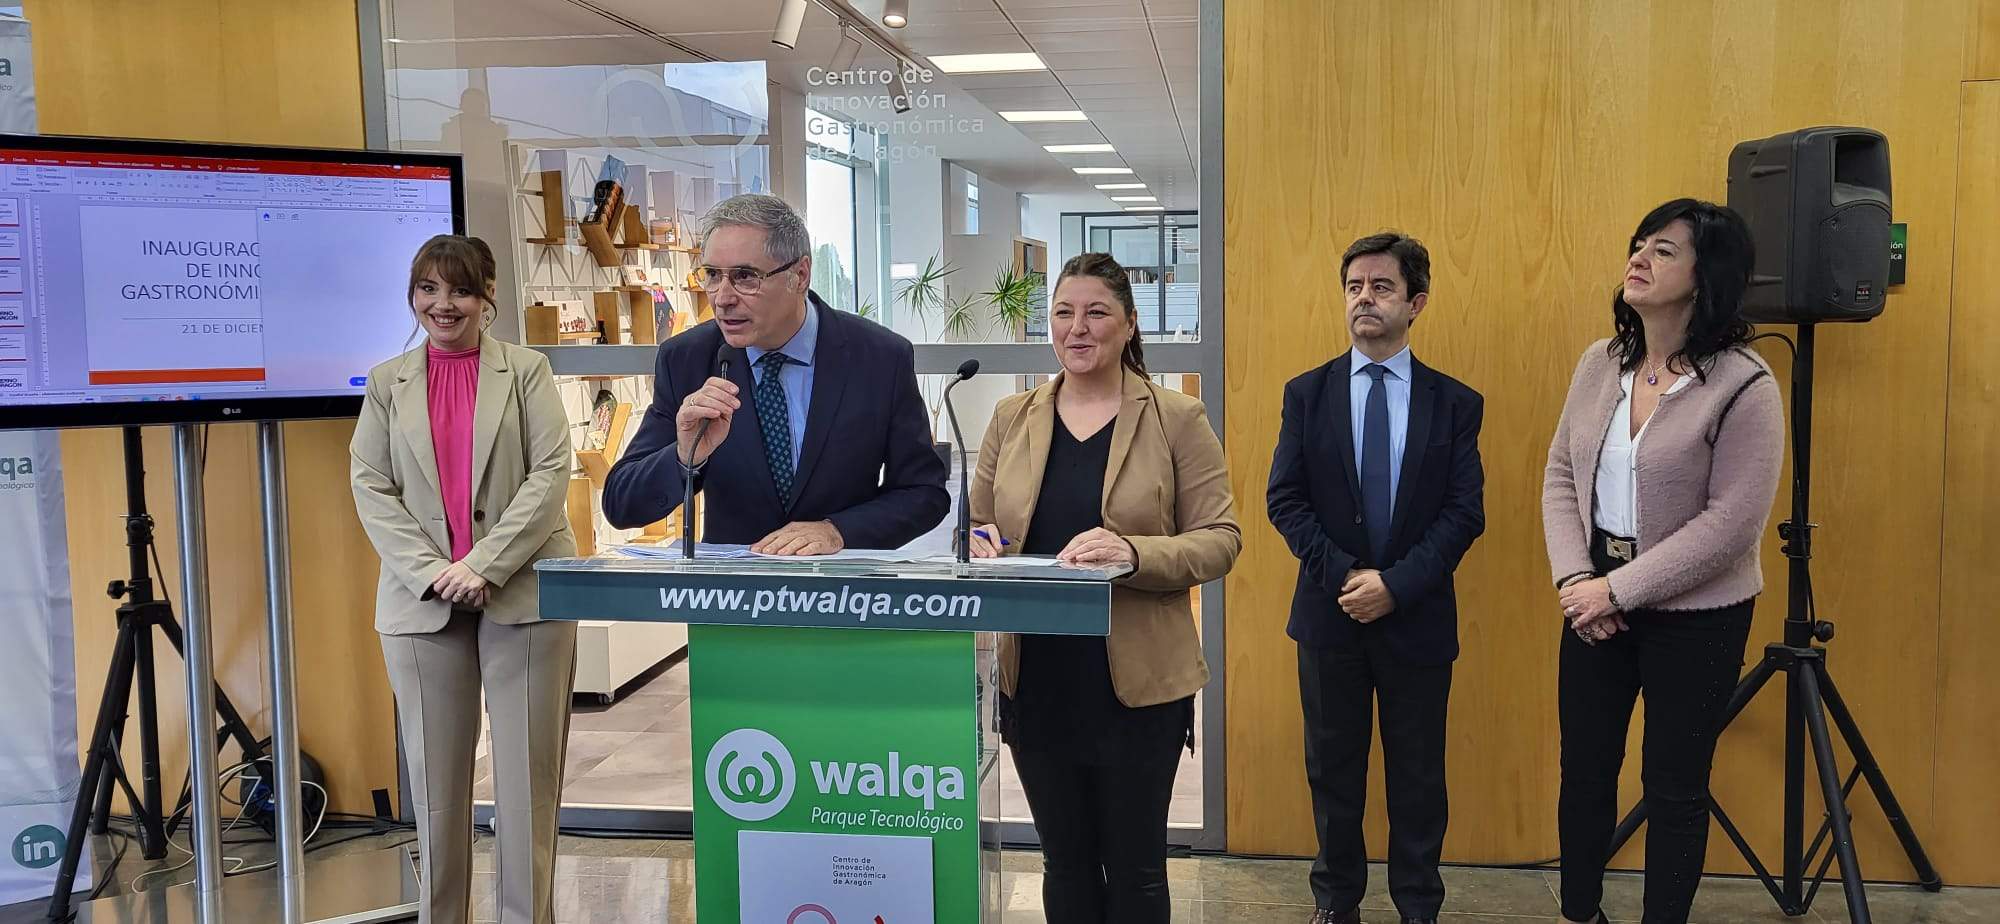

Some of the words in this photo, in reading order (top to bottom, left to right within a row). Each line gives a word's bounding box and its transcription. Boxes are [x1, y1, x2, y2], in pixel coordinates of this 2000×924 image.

[806, 66, 893, 86] Centro
[903, 65, 934, 84] de
[806, 89, 947, 111] Innovación
[808, 114, 985, 135] Gastronómica
[808, 142, 838, 160] de
[846, 141, 937, 164] Aagón
[187, 263, 212, 278] DE
[121, 281, 259, 300] GASTRONÓMI
[181, 324, 199, 334] 21
[203, 324, 220, 334] DE
[659, 584, 982, 622] www.ptwalqa.com
[809, 751, 965, 811] walqa
[811, 806, 867, 830] Parque
[870, 809, 965, 834] Tecnológico
[22, 835, 57, 862] in
[832, 855, 859, 863] Centro
[832, 863, 875, 871] Innovación
[832, 870, 887, 879] Gastronómica
[844, 879, 873, 887] Aragón
